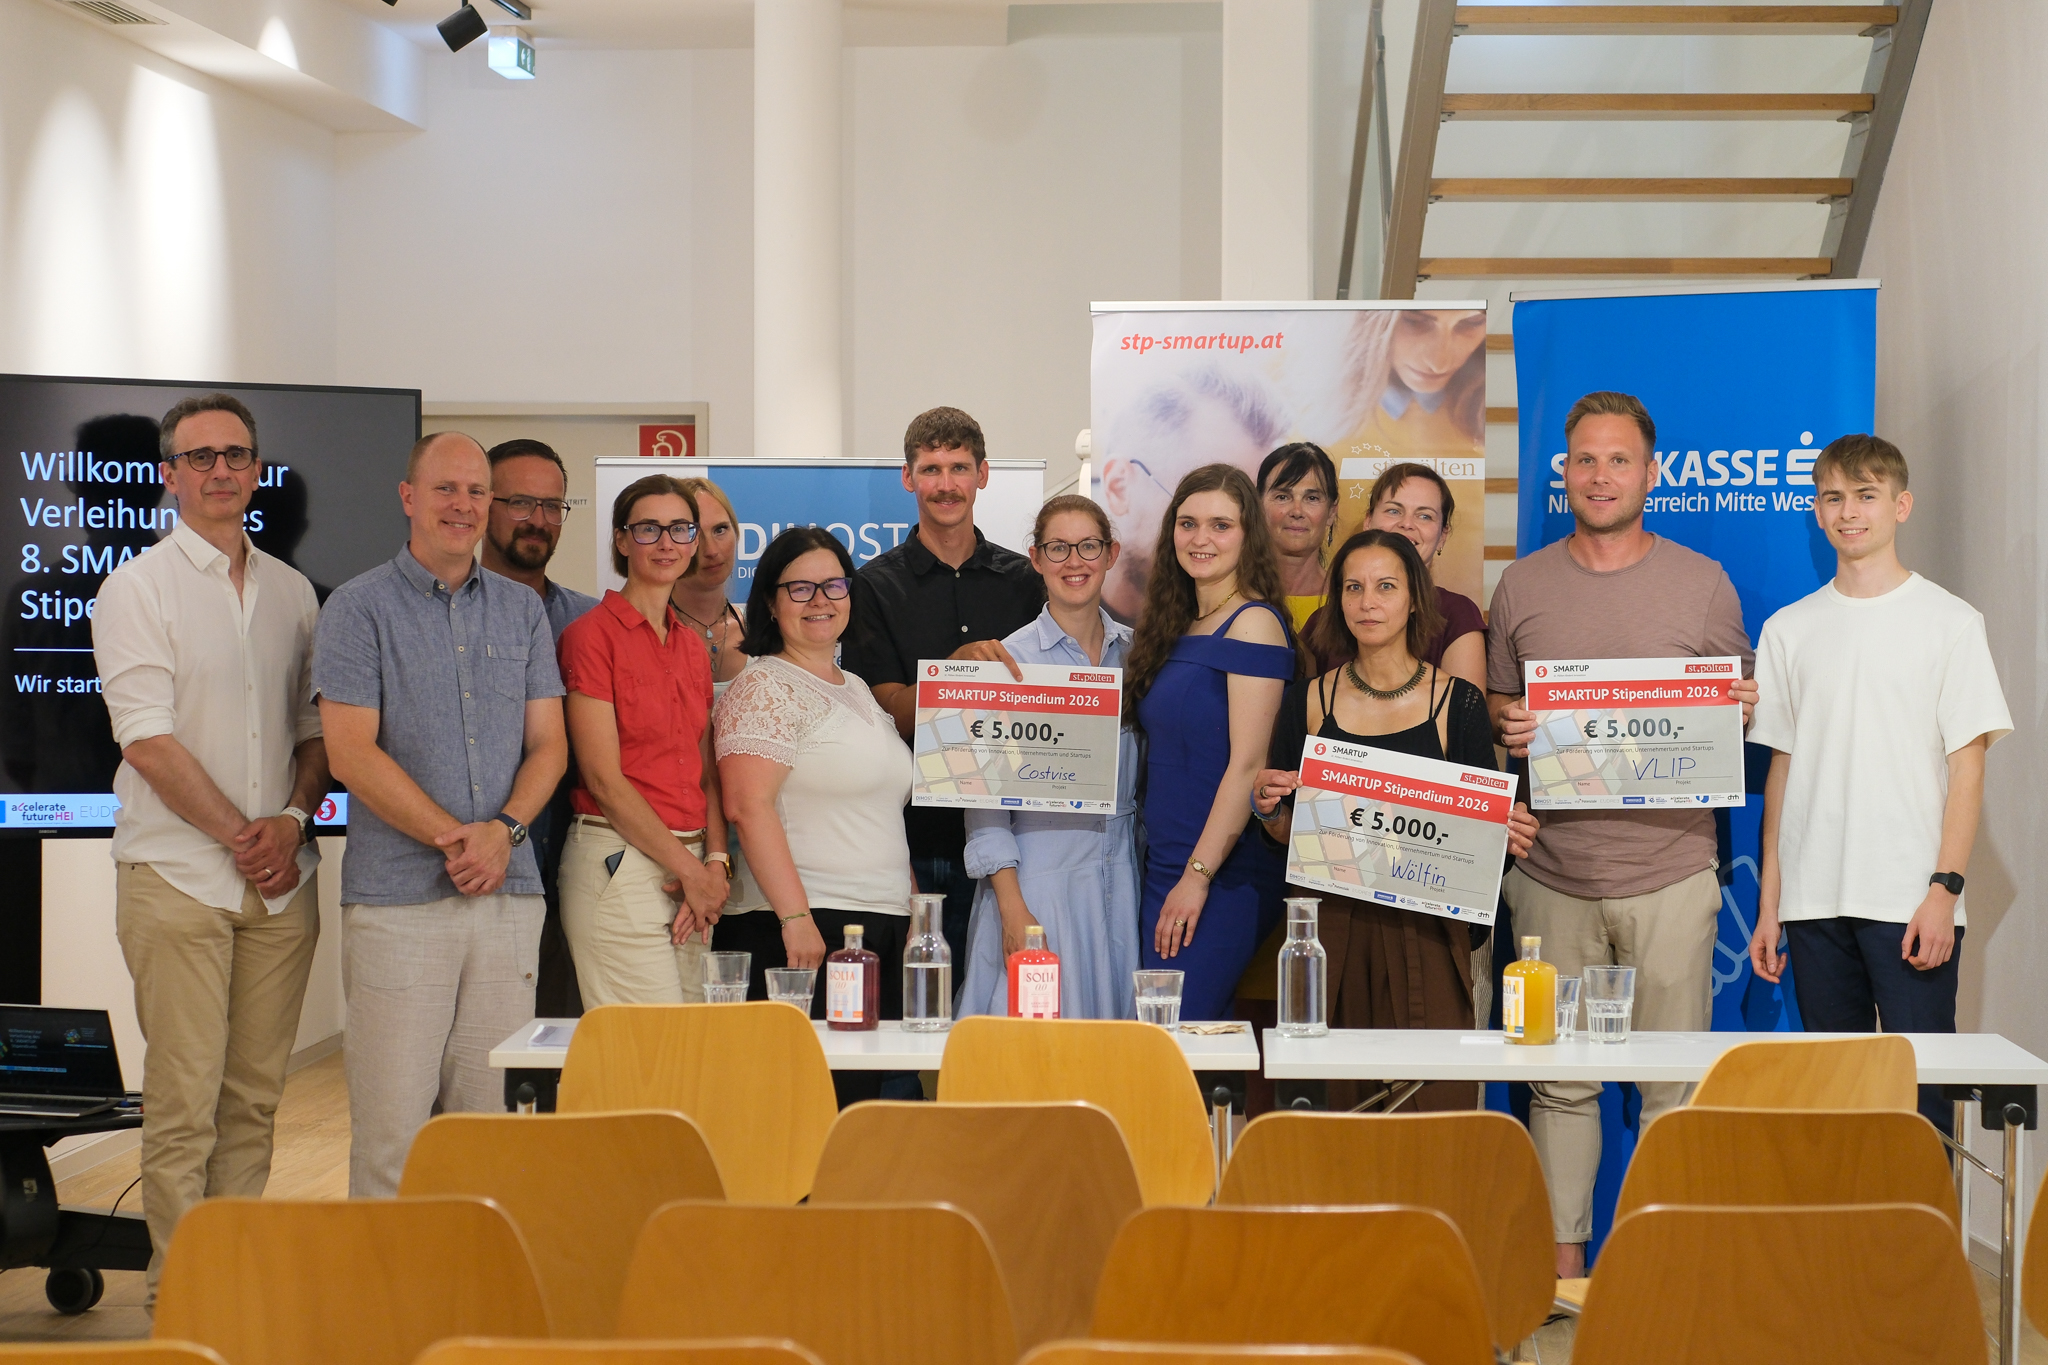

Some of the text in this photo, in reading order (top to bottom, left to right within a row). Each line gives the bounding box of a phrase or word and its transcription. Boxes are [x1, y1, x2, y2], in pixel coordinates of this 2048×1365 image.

[1121, 331, 1284, 355] stp-smartup.at
[20, 451, 290, 488] Willkom ur
[1550, 449, 1779, 489] SKASSE
[566, 498, 588, 506] TRITT
[1548, 491, 1815, 514] Nierreich Mitte Wes
[20, 497, 178, 530] Verleihun
[20, 543, 50, 574] 8.
[20, 589, 98, 627] Stipe
[944, 665, 980, 673] SMARTUP
[1072, 673, 1112, 683] st.pölten
[1553, 664, 1590, 673] SMARTUP
[1688, 663, 1730, 674] st.pölten
[14, 674, 103, 694] Wir start
[1548, 685, 1719, 703] SMARTUP Stipendium 2026
[938, 688, 1100, 707] SMARTUP Stipendium 2026
[970, 720, 1065, 745] € 5.000,-
[1584, 718, 1685, 739] € 5.000,-
[1332, 745, 1369, 759] SMARTUP
[1018, 763, 1077, 781] Costvise
[1633, 756, 1697, 781] VLIP
[1321, 769, 1489, 812] SMARTUP Stipendium 2026
[1463, 772, 1506, 789] st.pölten
[22, 811, 74, 821] futureHEI
[1350, 807, 1449, 845] € 5.000,-
[1452, 855, 1475, 865] Startups
[1391, 856, 1446, 887] Wölfin
[1026, 972, 1054, 983] SOLIA
